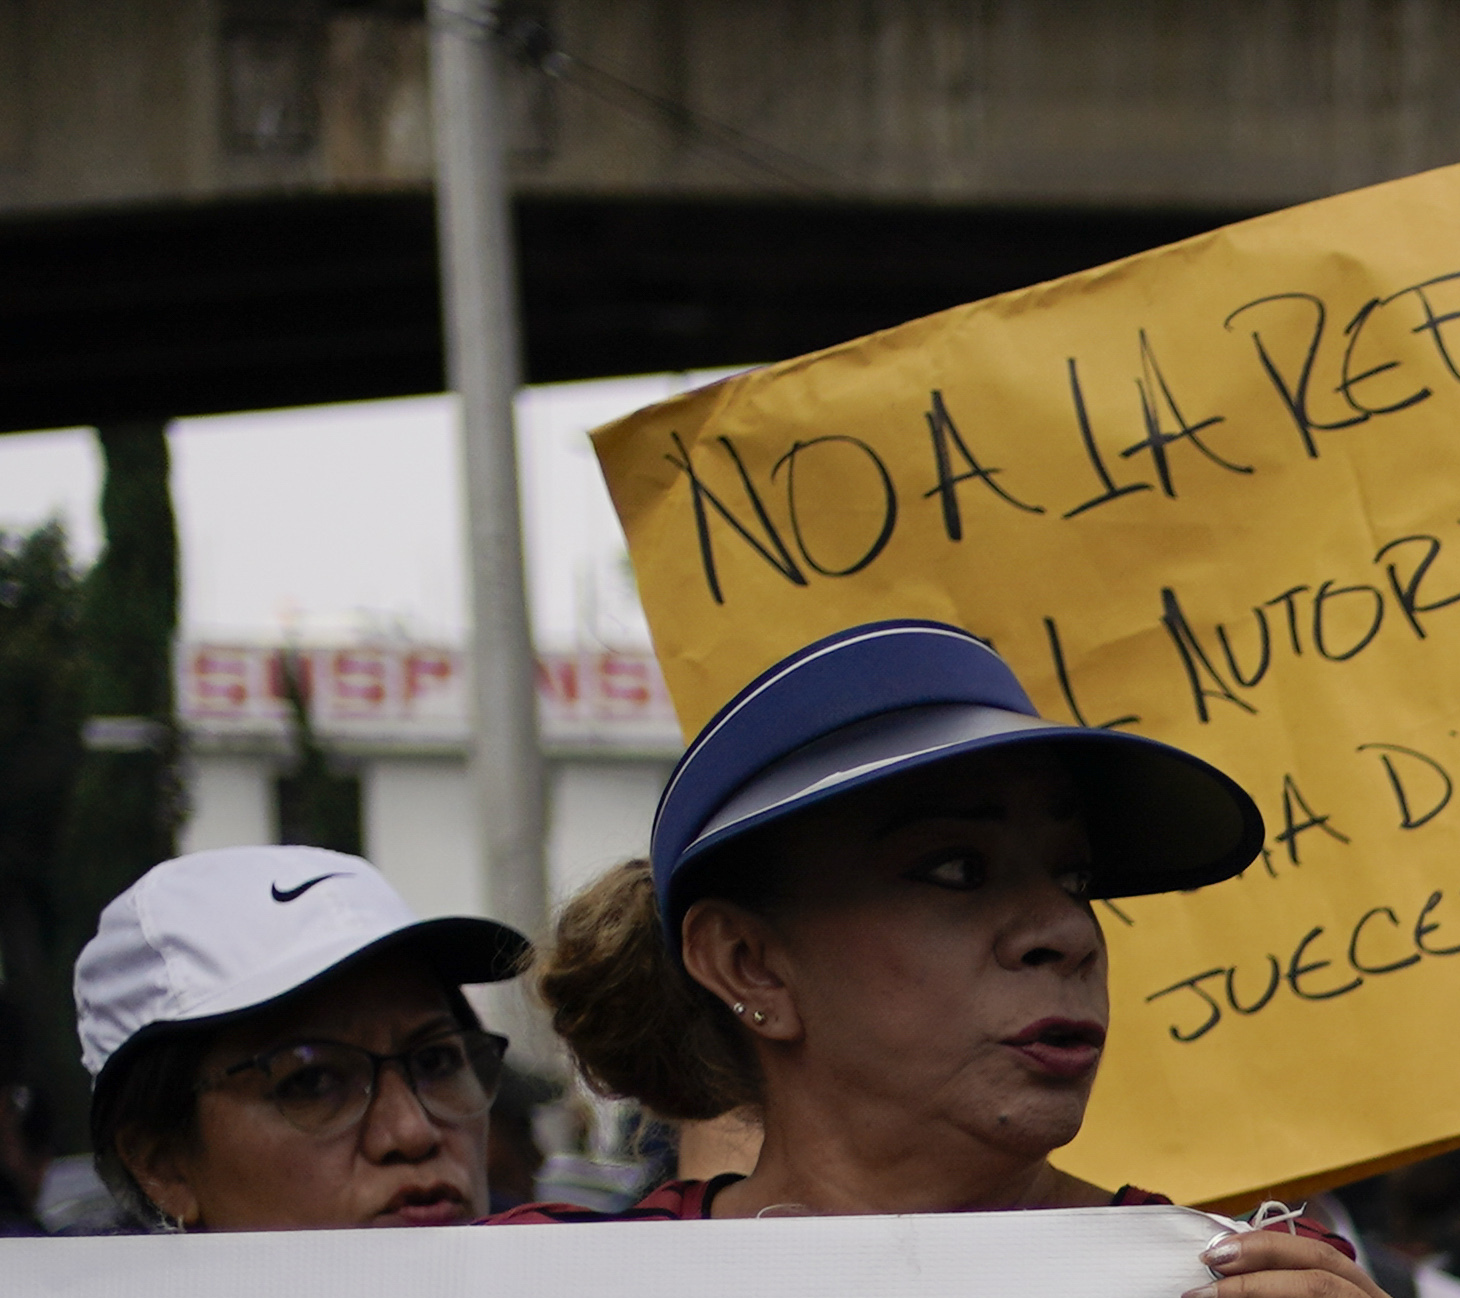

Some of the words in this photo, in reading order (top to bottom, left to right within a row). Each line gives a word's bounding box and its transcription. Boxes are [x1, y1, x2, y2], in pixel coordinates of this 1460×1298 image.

[662, 430, 900, 607] NO
[921, 388, 1047, 544] A
[1062, 328, 1257, 522] LA
